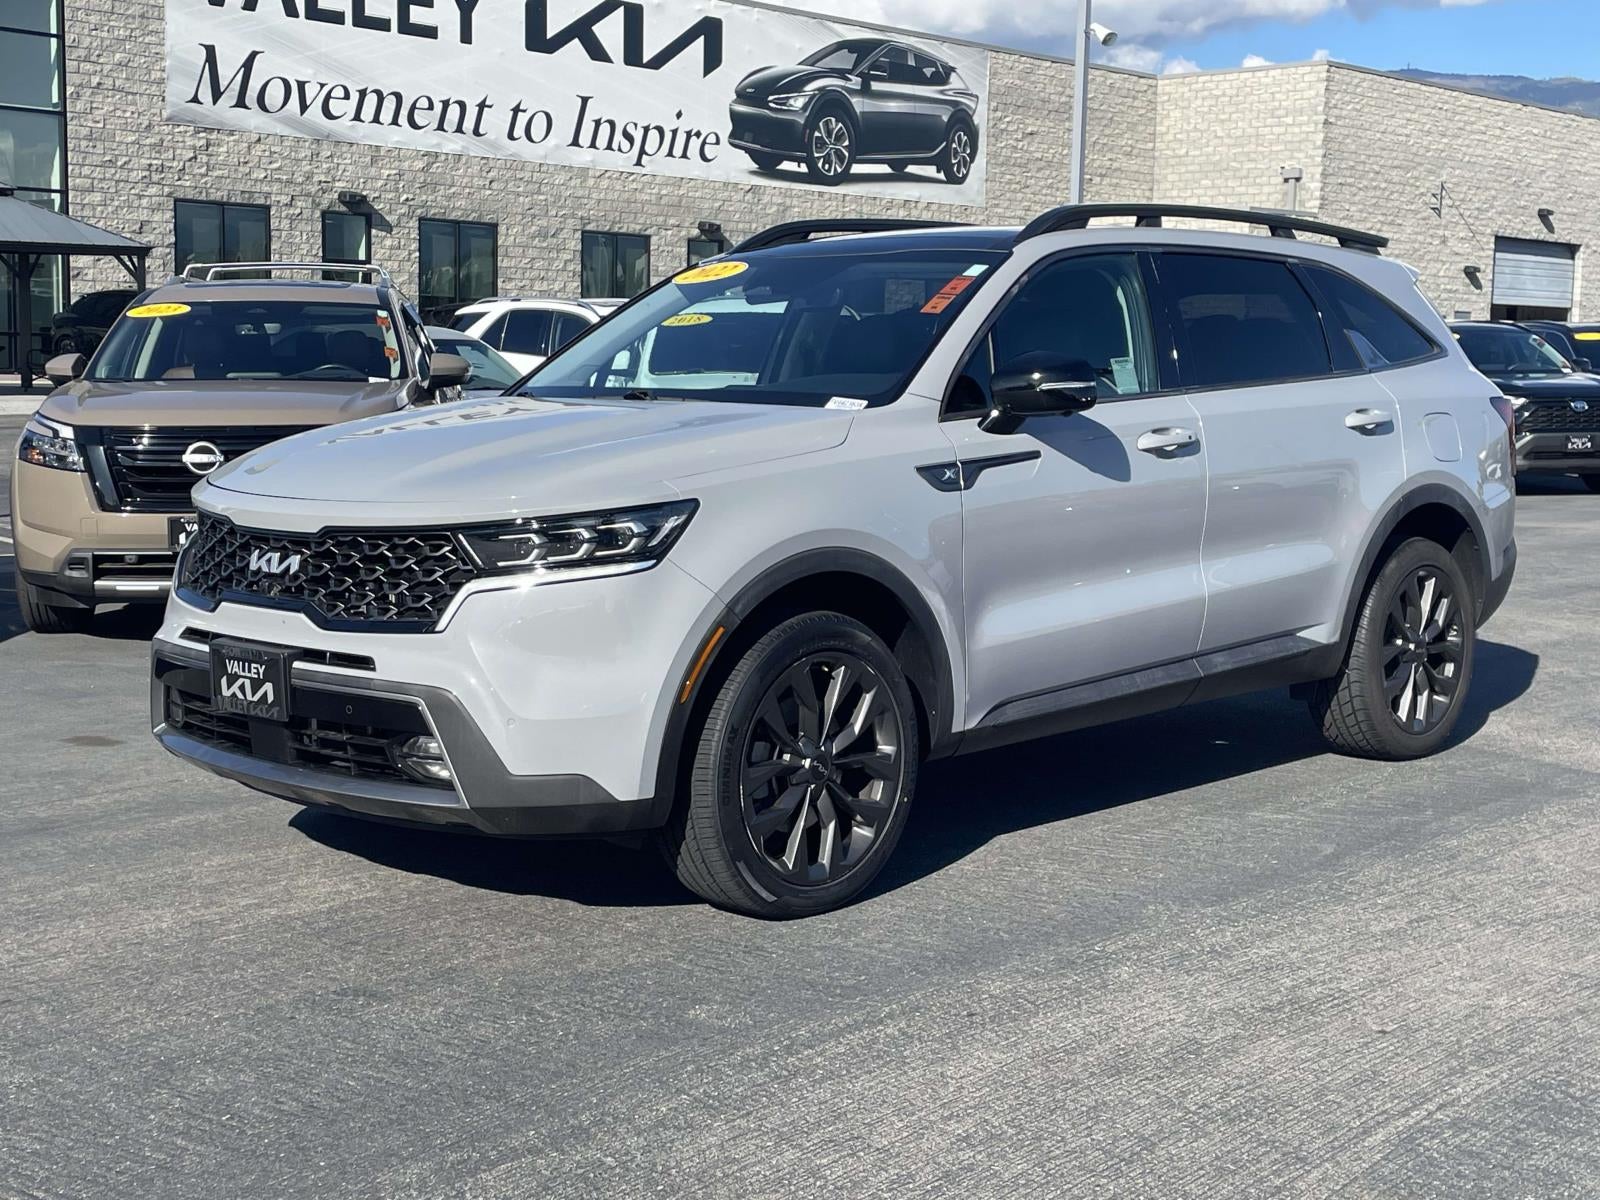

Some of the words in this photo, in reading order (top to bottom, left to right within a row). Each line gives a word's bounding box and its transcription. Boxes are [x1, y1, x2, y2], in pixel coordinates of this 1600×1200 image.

[525, 0, 723, 78] KIA
[186, 43, 491, 138] Movement
[507, 99, 553, 144] to
[565, 95, 721, 168] Inspire
[249, 549, 301, 575] KIA
[225, 658, 266, 680] VALLEY
[220, 675, 275, 705] KIA
